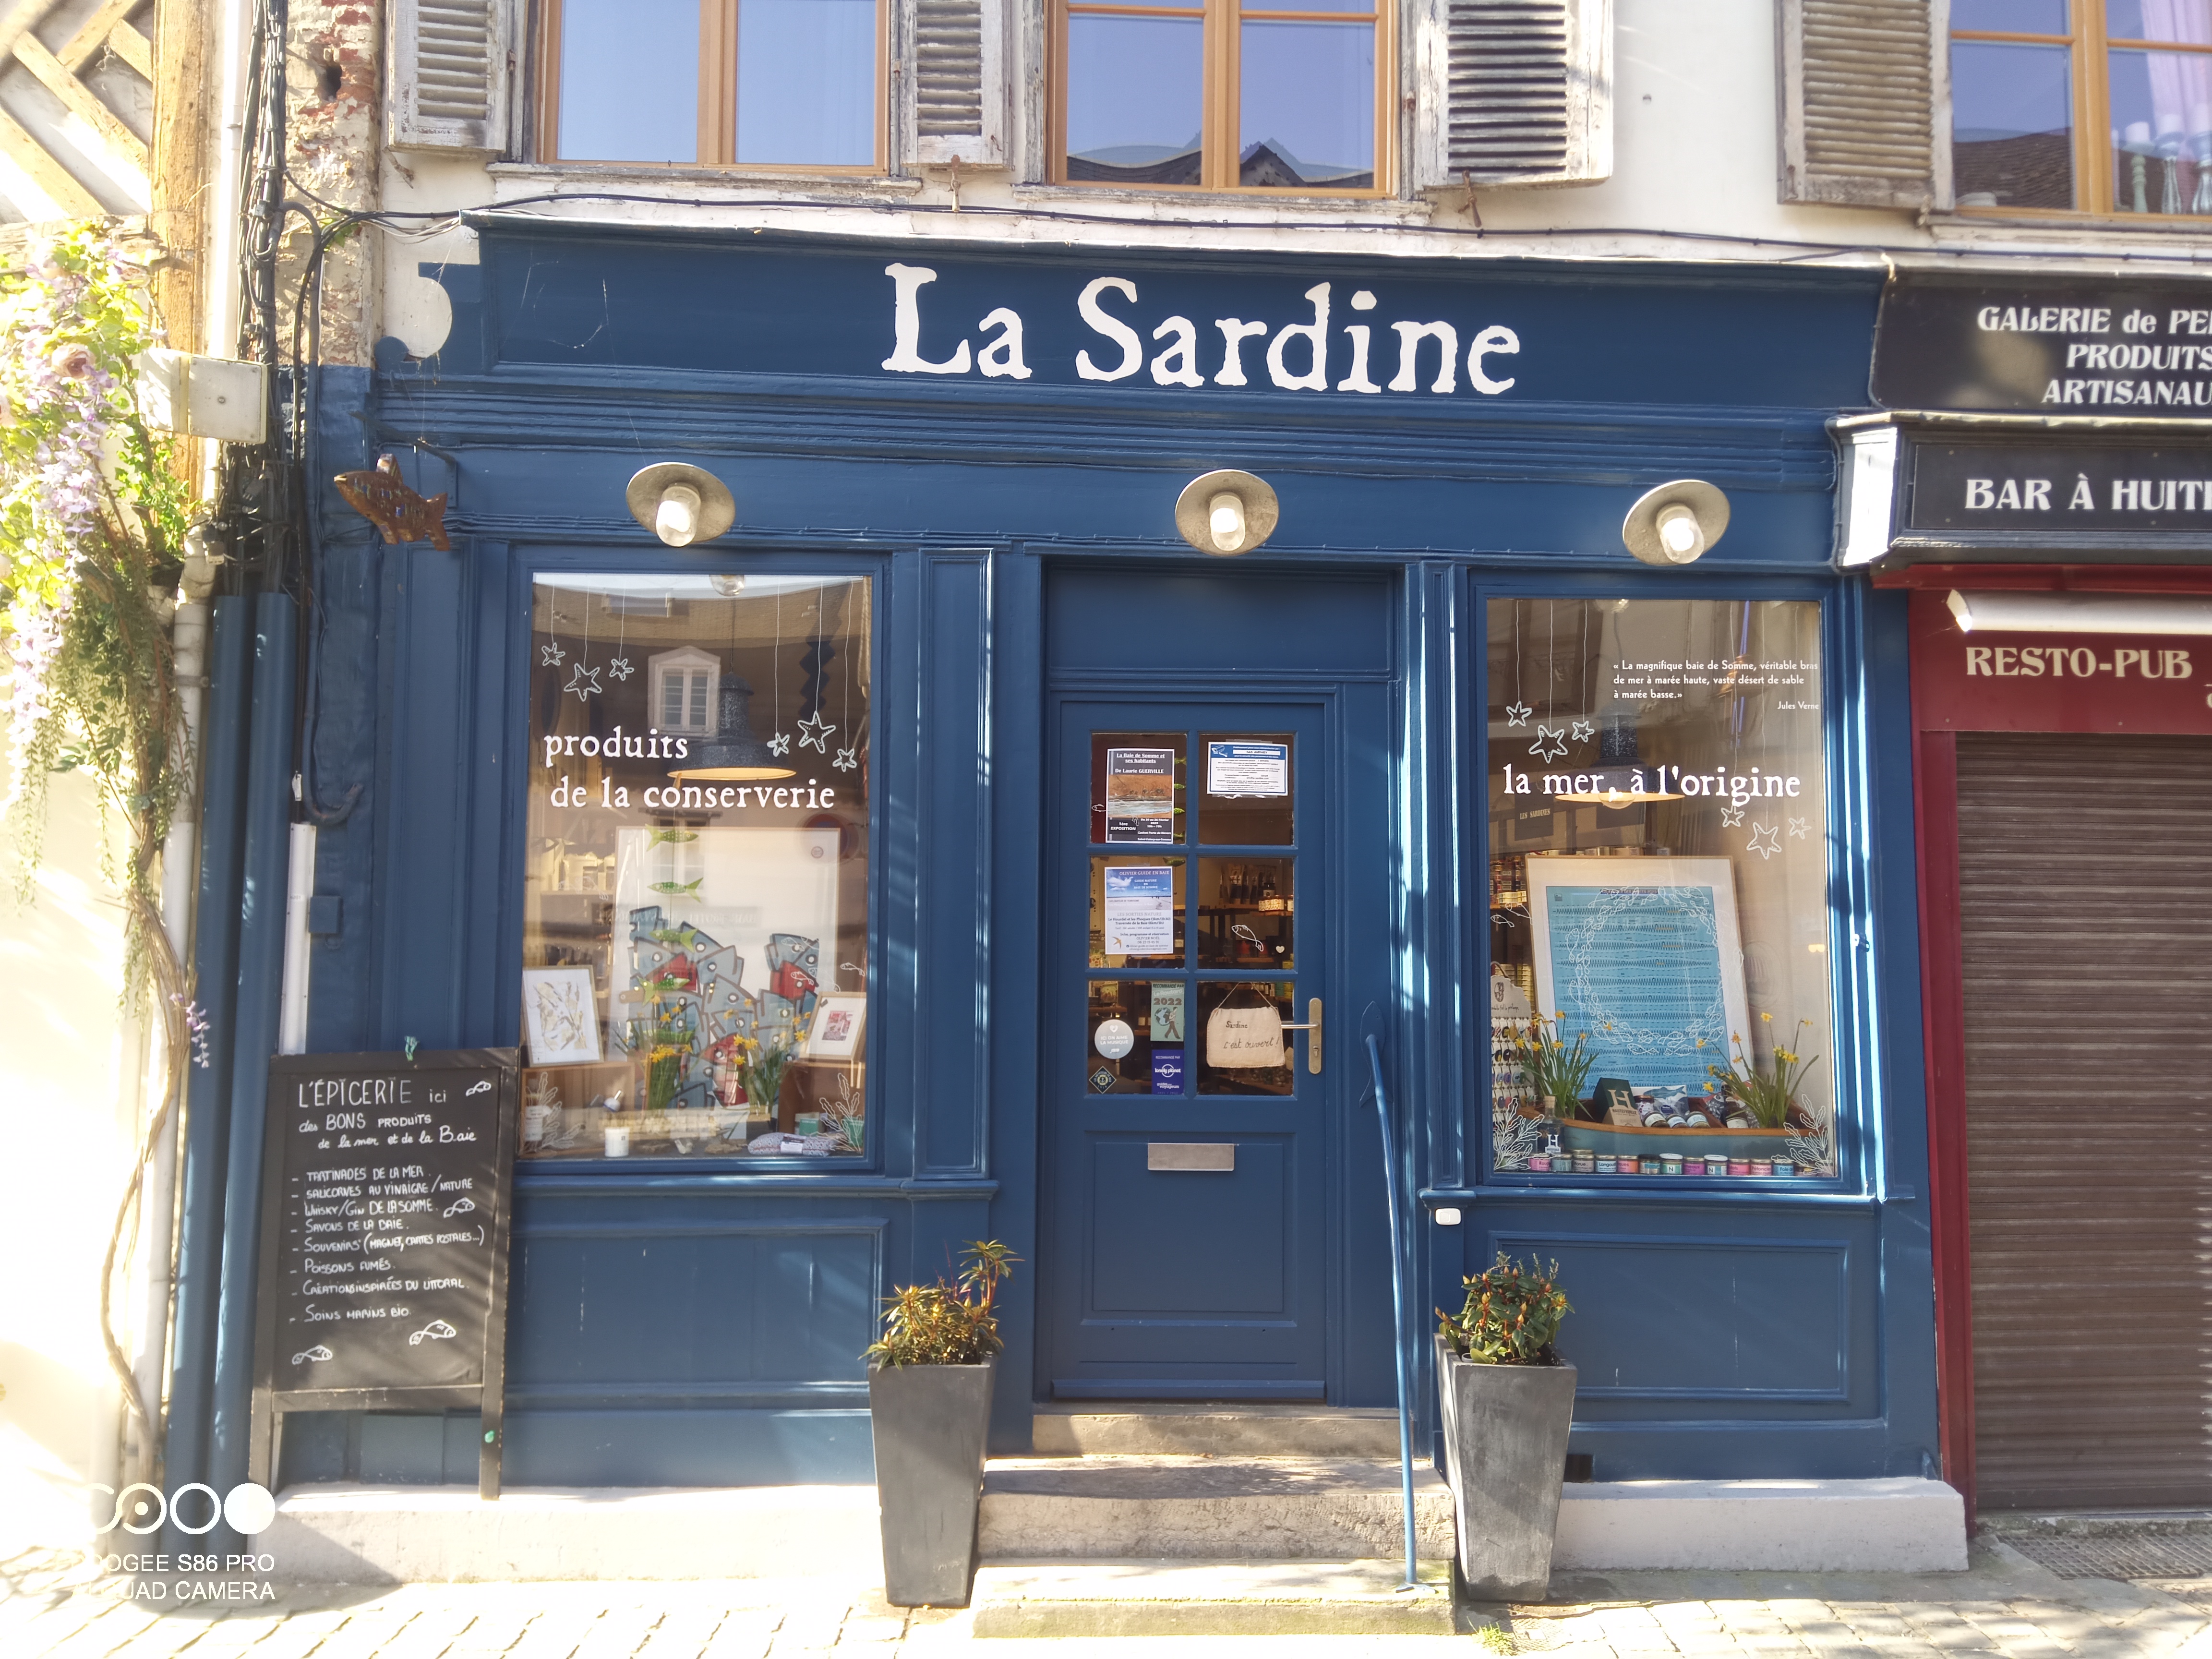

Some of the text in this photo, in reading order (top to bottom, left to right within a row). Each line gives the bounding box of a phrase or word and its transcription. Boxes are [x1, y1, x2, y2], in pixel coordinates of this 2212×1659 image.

[1978, 306, 2110, 333] GALERIE
[2123, 310, 2156, 334] de
[881, 263, 1520, 394] La Sardine
[2067, 344, 2212, 370] PRODUITS
[1965, 479, 2051, 510] BAR
[2068, 473, 2094, 510] À
[1622, 660, 1633, 670] La
[1636, 660, 1682, 672] magnifique
[1686, 660, 1704, 670] baie
[1707, 660, 1719, 670] de
[1722, 661, 1756, 671] Somme,
[1760, 661, 1797, 670] véritable
[1801, 661, 1817, 670] bras
[1966, 647, 2192, 678] RESTO-PUB
[1613, 674, 1624, 684] de
[1647, 675, 1651, 684] à
[1655, 675, 1680, 685] marée
[1684, 674, 1709, 685] haute,
[1713, 676, 1735, 685] vaste
[1738, 674, 1764, 685] désert
[1767, 674, 1779, 684] de
[1782, 674, 1804, 685] sable
[1613, 690, 1618, 698] à
[1622, 690, 1647, 699] marée
[1778, 701, 1819, 710] Jules Verne
[544, 726, 688, 768] produits
[550, 775, 834, 808] de la conserverie
[1503, 764, 1531, 795] la
[1630, 768, 1645, 795] à
[1658, 765, 1800, 806] l'origine
[1530, 808, 1550, 817] SARDINES
[1223, 1038, 1241, 1049] c'est
[430, 1089, 446, 1103] ici
[299, 1119, 318, 1132] des
[326, 1112, 366, 1130] BONS
[318, 1138, 330, 1149] de
[338, 1134, 351, 1148] la
[387, 1133, 398, 1144] et
[401, 1132, 413, 1144] de
[419, 1130, 433, 1143] la
[439, 1125, 477, 1143] Baie
[373, 1168, 385, 1180] DE
[389, 1167, 399, 1178] LA
[369, 1185, 381, 1195] AU
[369, 1201, 384, 1215] DE
[387, 1201, 397, 1213] LA
[348, 1221, 360, 1232] DE
[363, 1221, 374, 1230] LA
[405, 1233, 433, 1246] CARTES
[405, 1279, 418, 1291] DU
